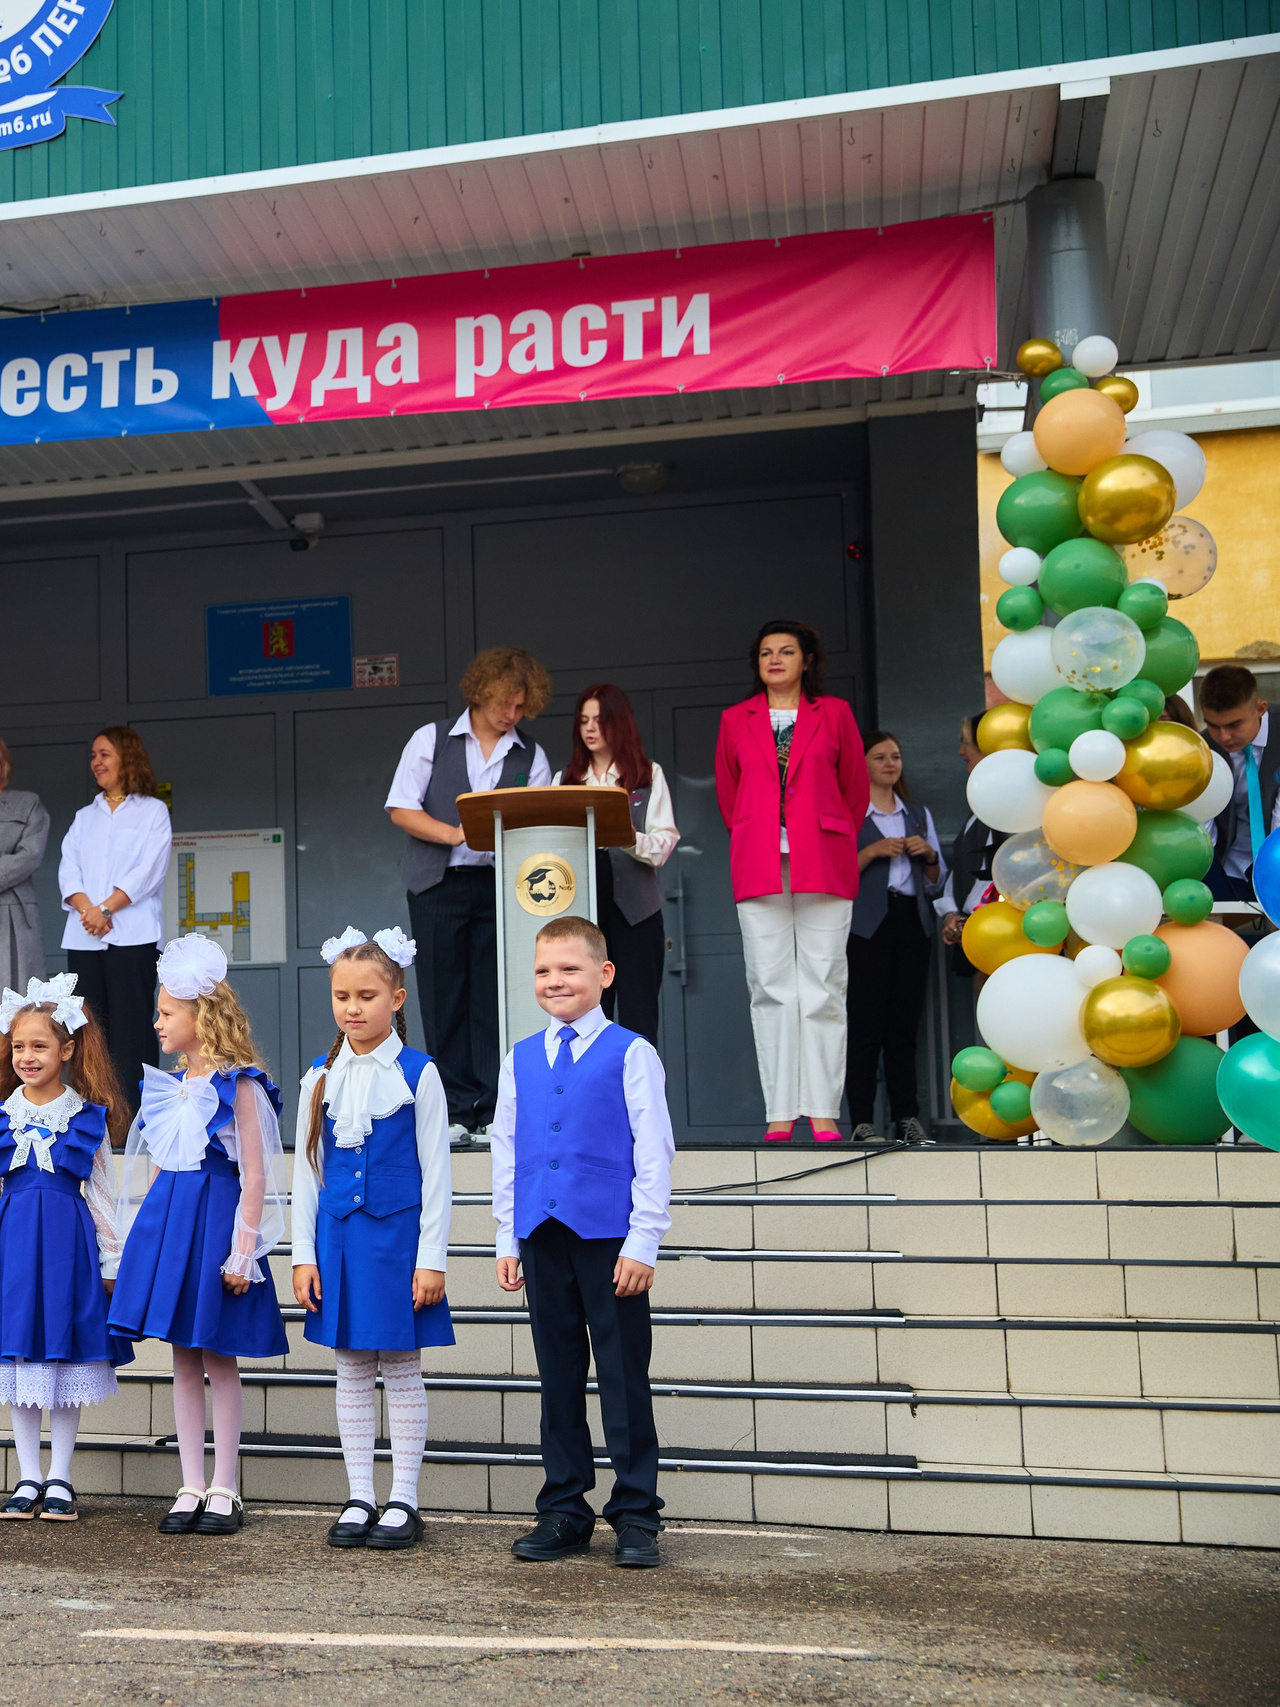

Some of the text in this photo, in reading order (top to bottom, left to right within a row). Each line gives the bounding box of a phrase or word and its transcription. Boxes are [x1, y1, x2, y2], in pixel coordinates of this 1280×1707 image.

[0, 347, 180, 417] есть
[211, 321, 420, 411] куда
[453, 292, 713, 397] расти
